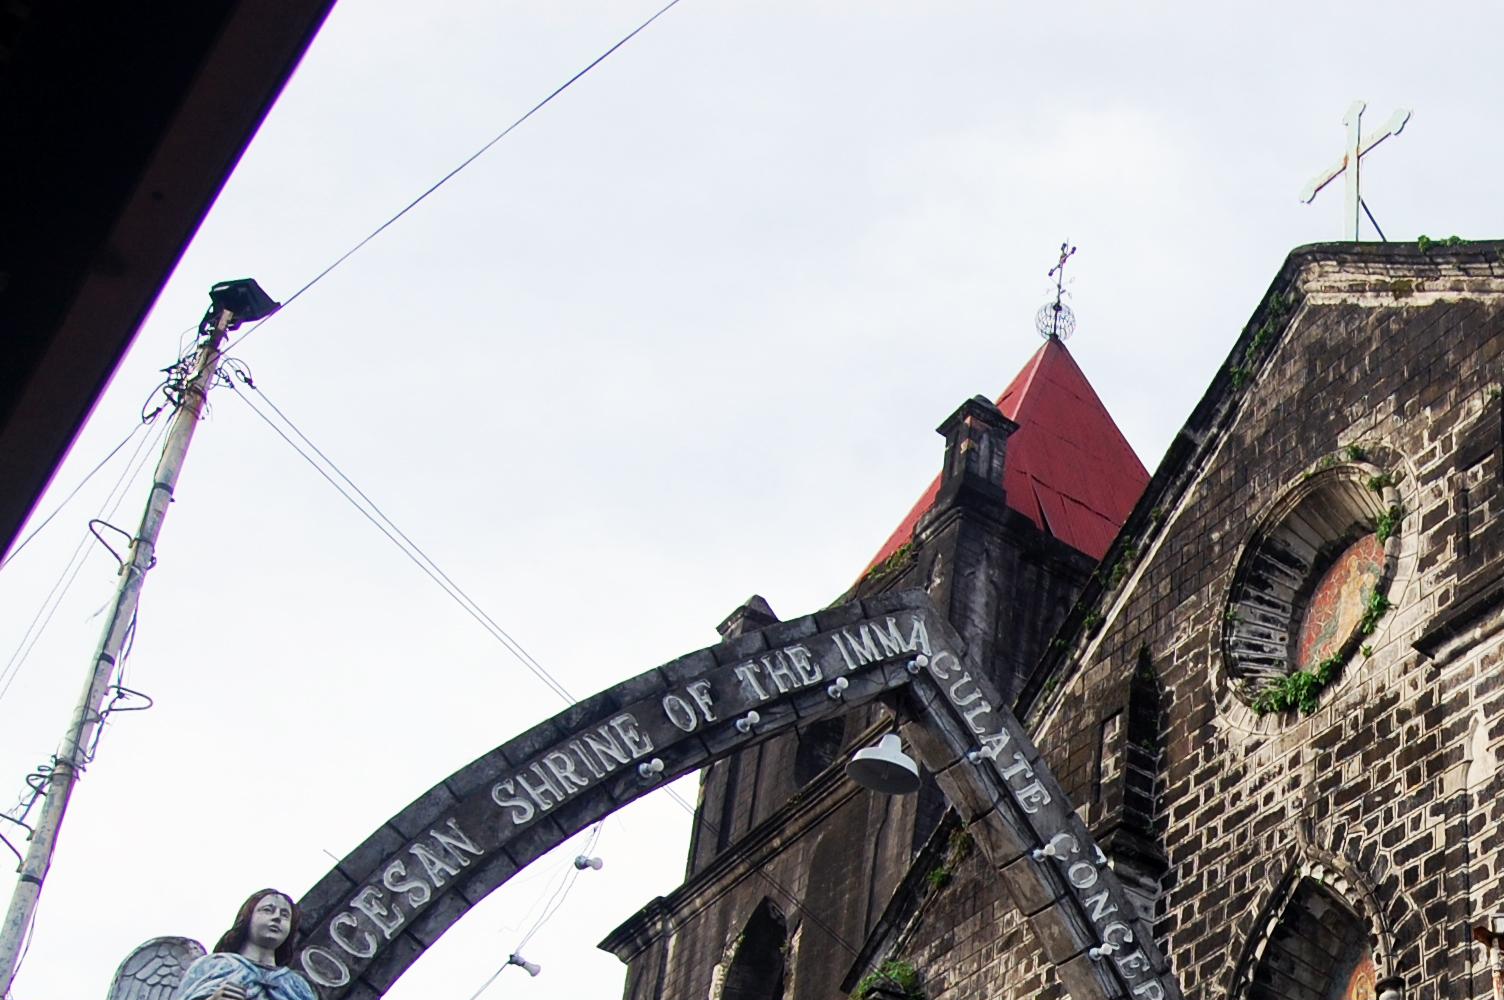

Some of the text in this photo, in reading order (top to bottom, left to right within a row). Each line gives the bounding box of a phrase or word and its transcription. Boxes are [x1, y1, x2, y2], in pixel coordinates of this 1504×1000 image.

[301, 817, 485, 989] OCESAN
[491, 712, 654, 825] SHRINE
[663, 679, 719, 732] OF
[735, 643, 824, 702] THE
